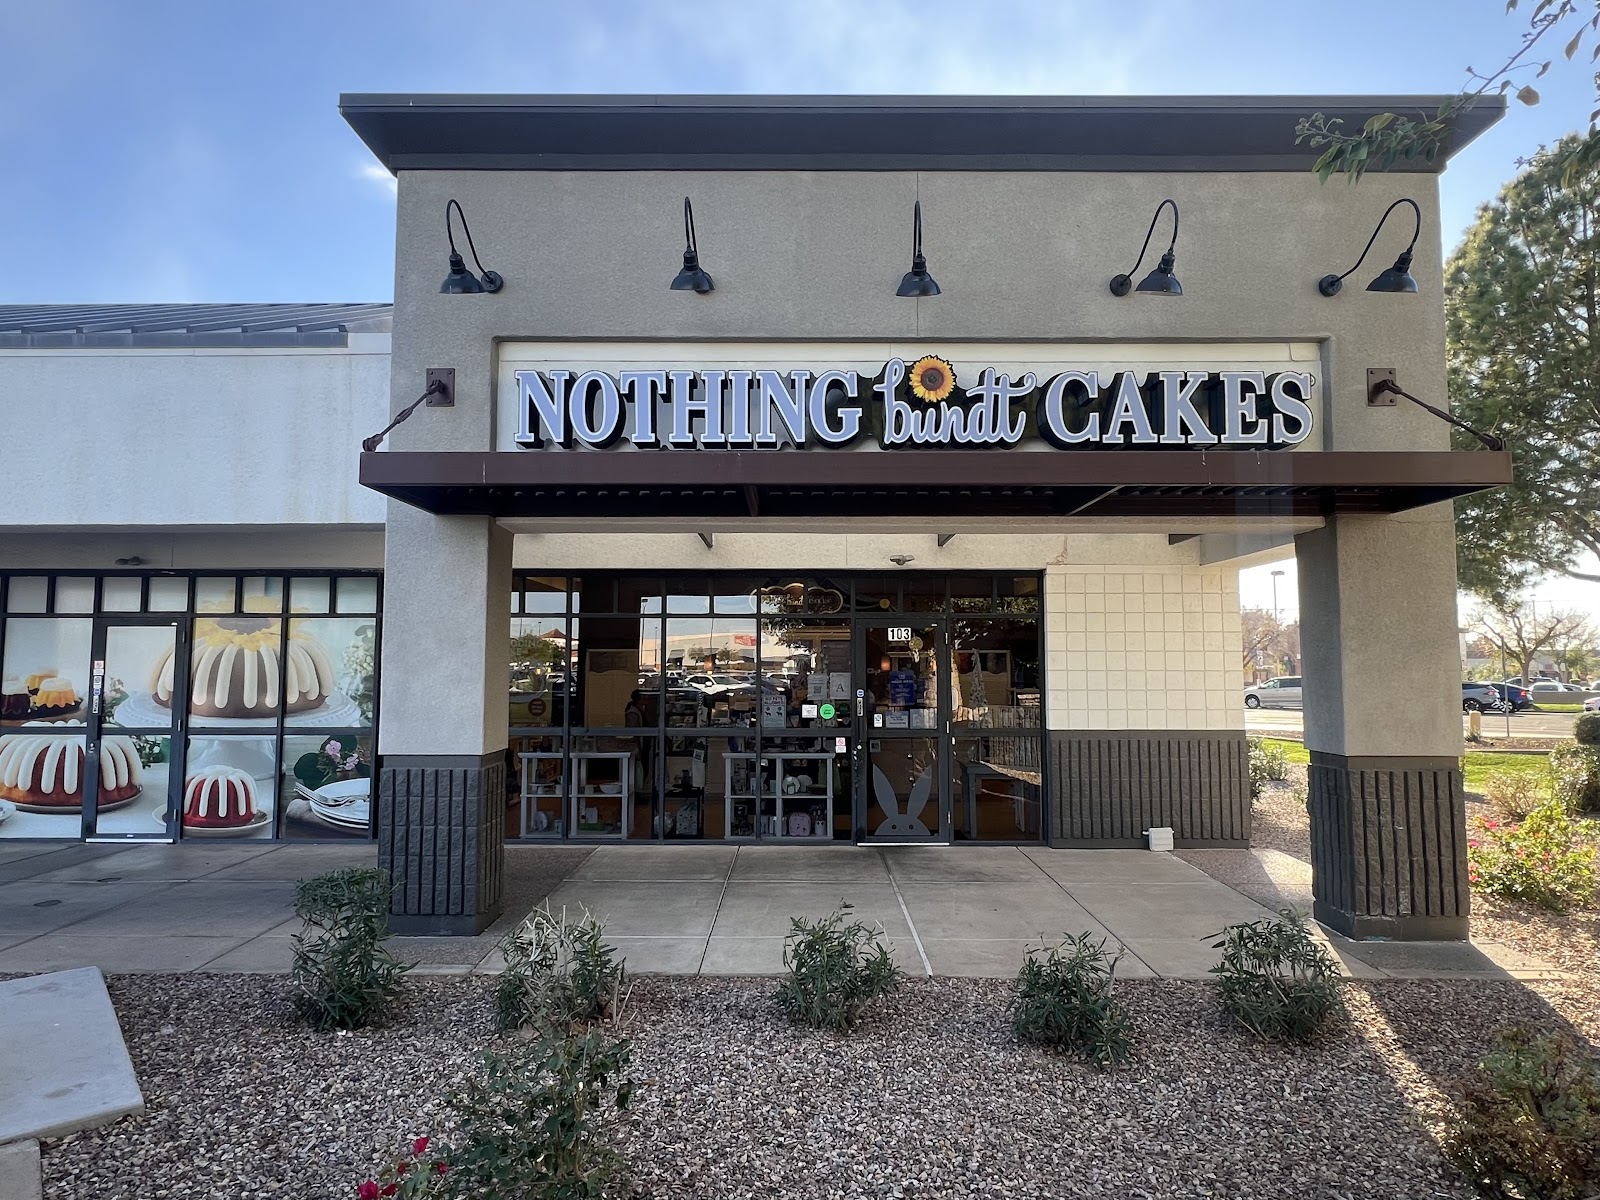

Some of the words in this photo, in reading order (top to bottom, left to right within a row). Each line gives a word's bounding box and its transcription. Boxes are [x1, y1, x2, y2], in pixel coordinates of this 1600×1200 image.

[514, 370, 863, 443] NOTHING
[873, 357, 1037, 444] bundt
[1045, 371, 1315, 444] CAKES
[890, 628, 910, 640] 103
